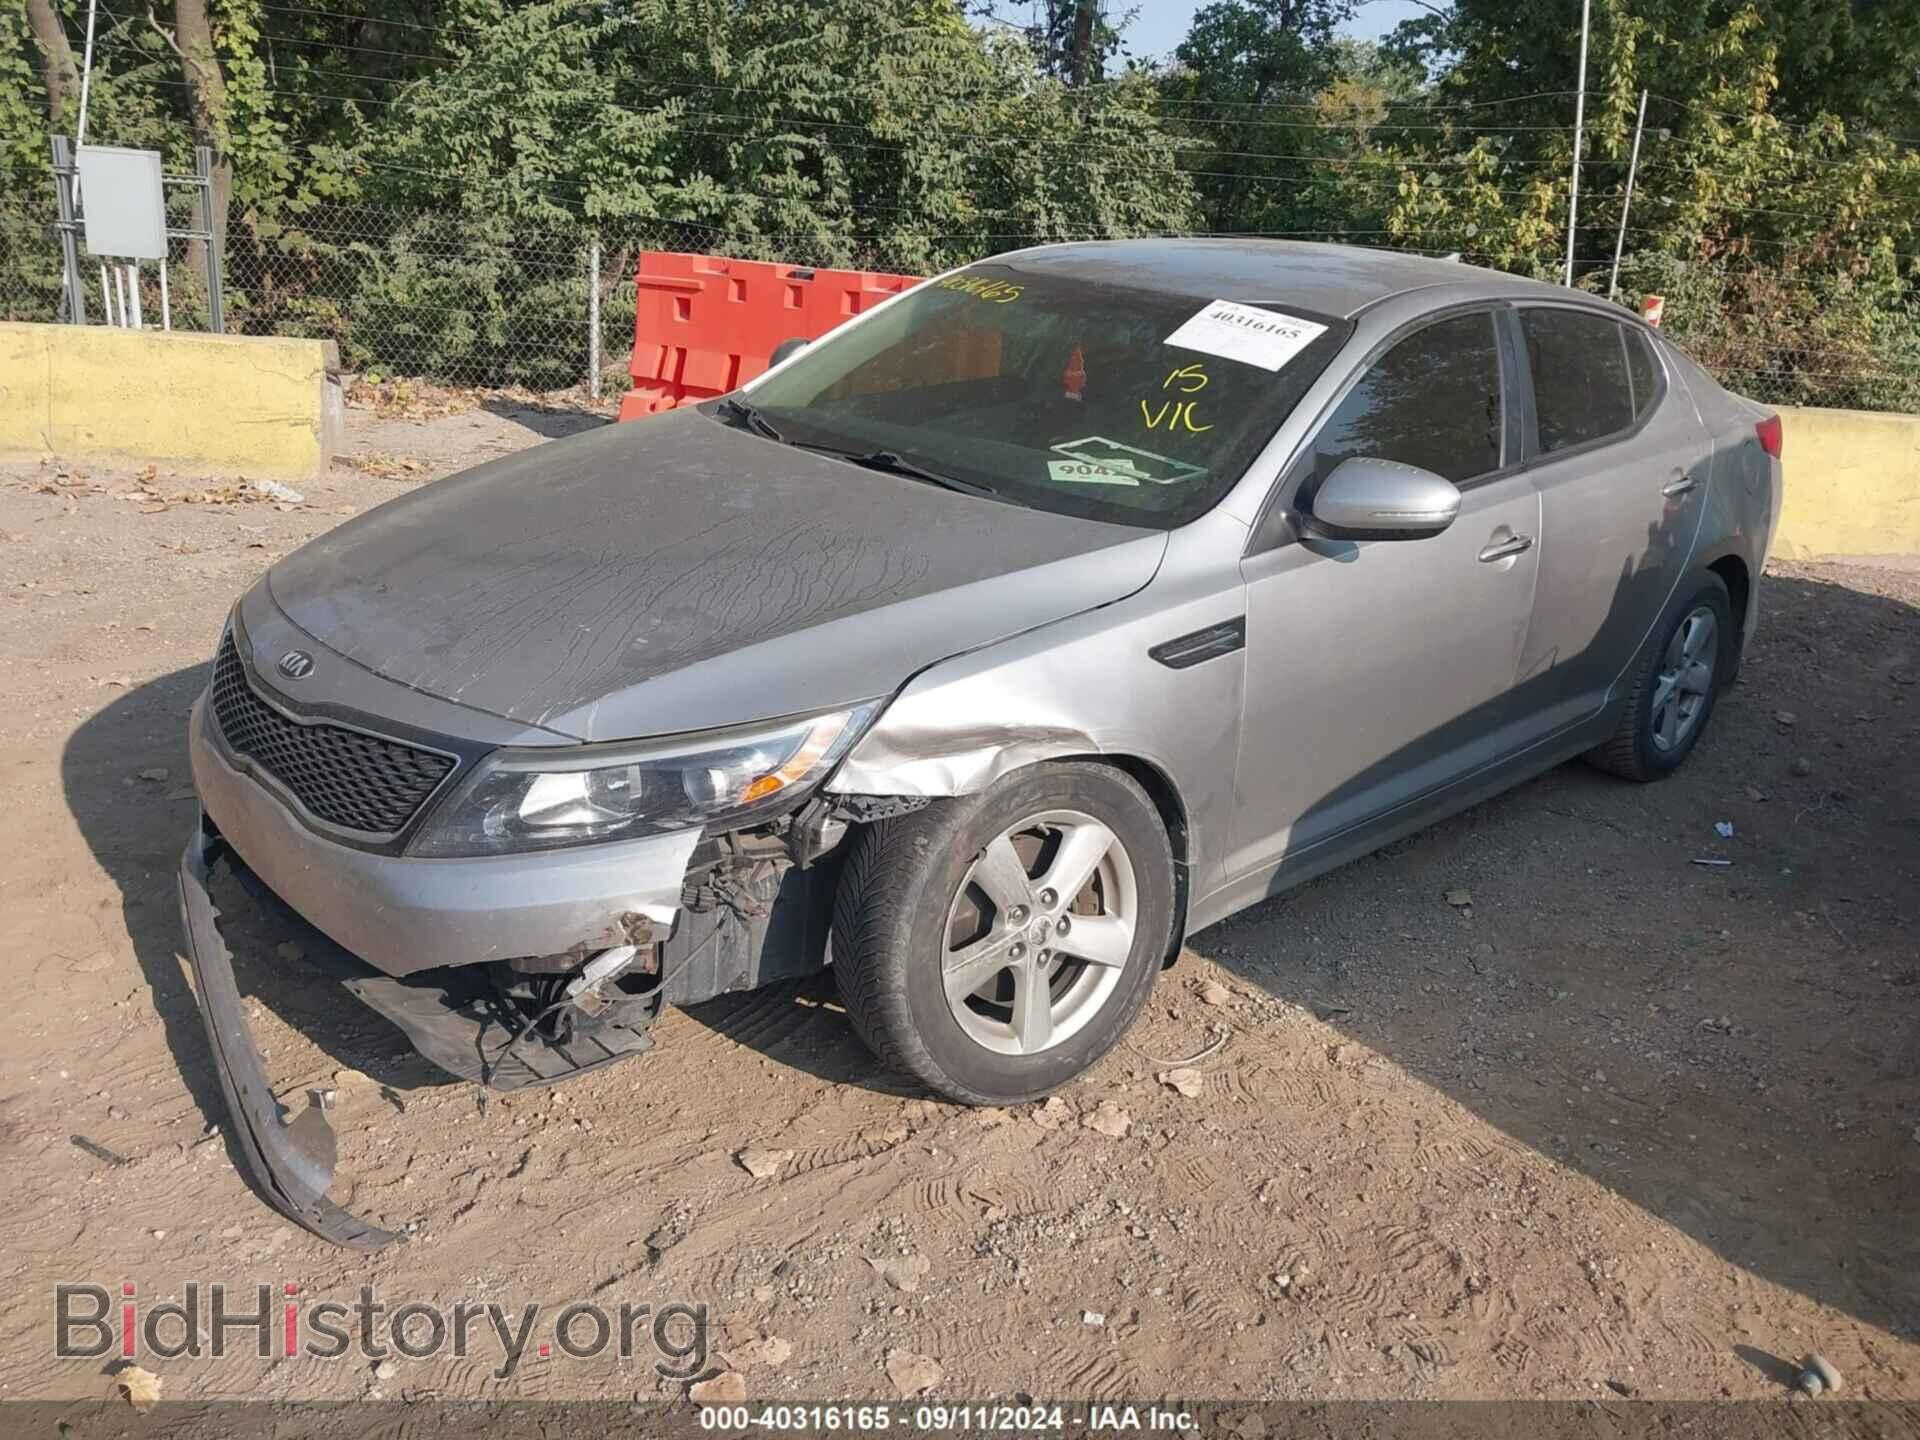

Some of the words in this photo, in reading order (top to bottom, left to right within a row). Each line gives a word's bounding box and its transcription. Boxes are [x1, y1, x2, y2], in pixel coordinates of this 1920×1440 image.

[1210, 311, 1301, 339] 40316165
[1141, 399, 1215, 432] VIC
[1059, 464, 1121, 477] 904
[280, 652, 309, 676] KIA
